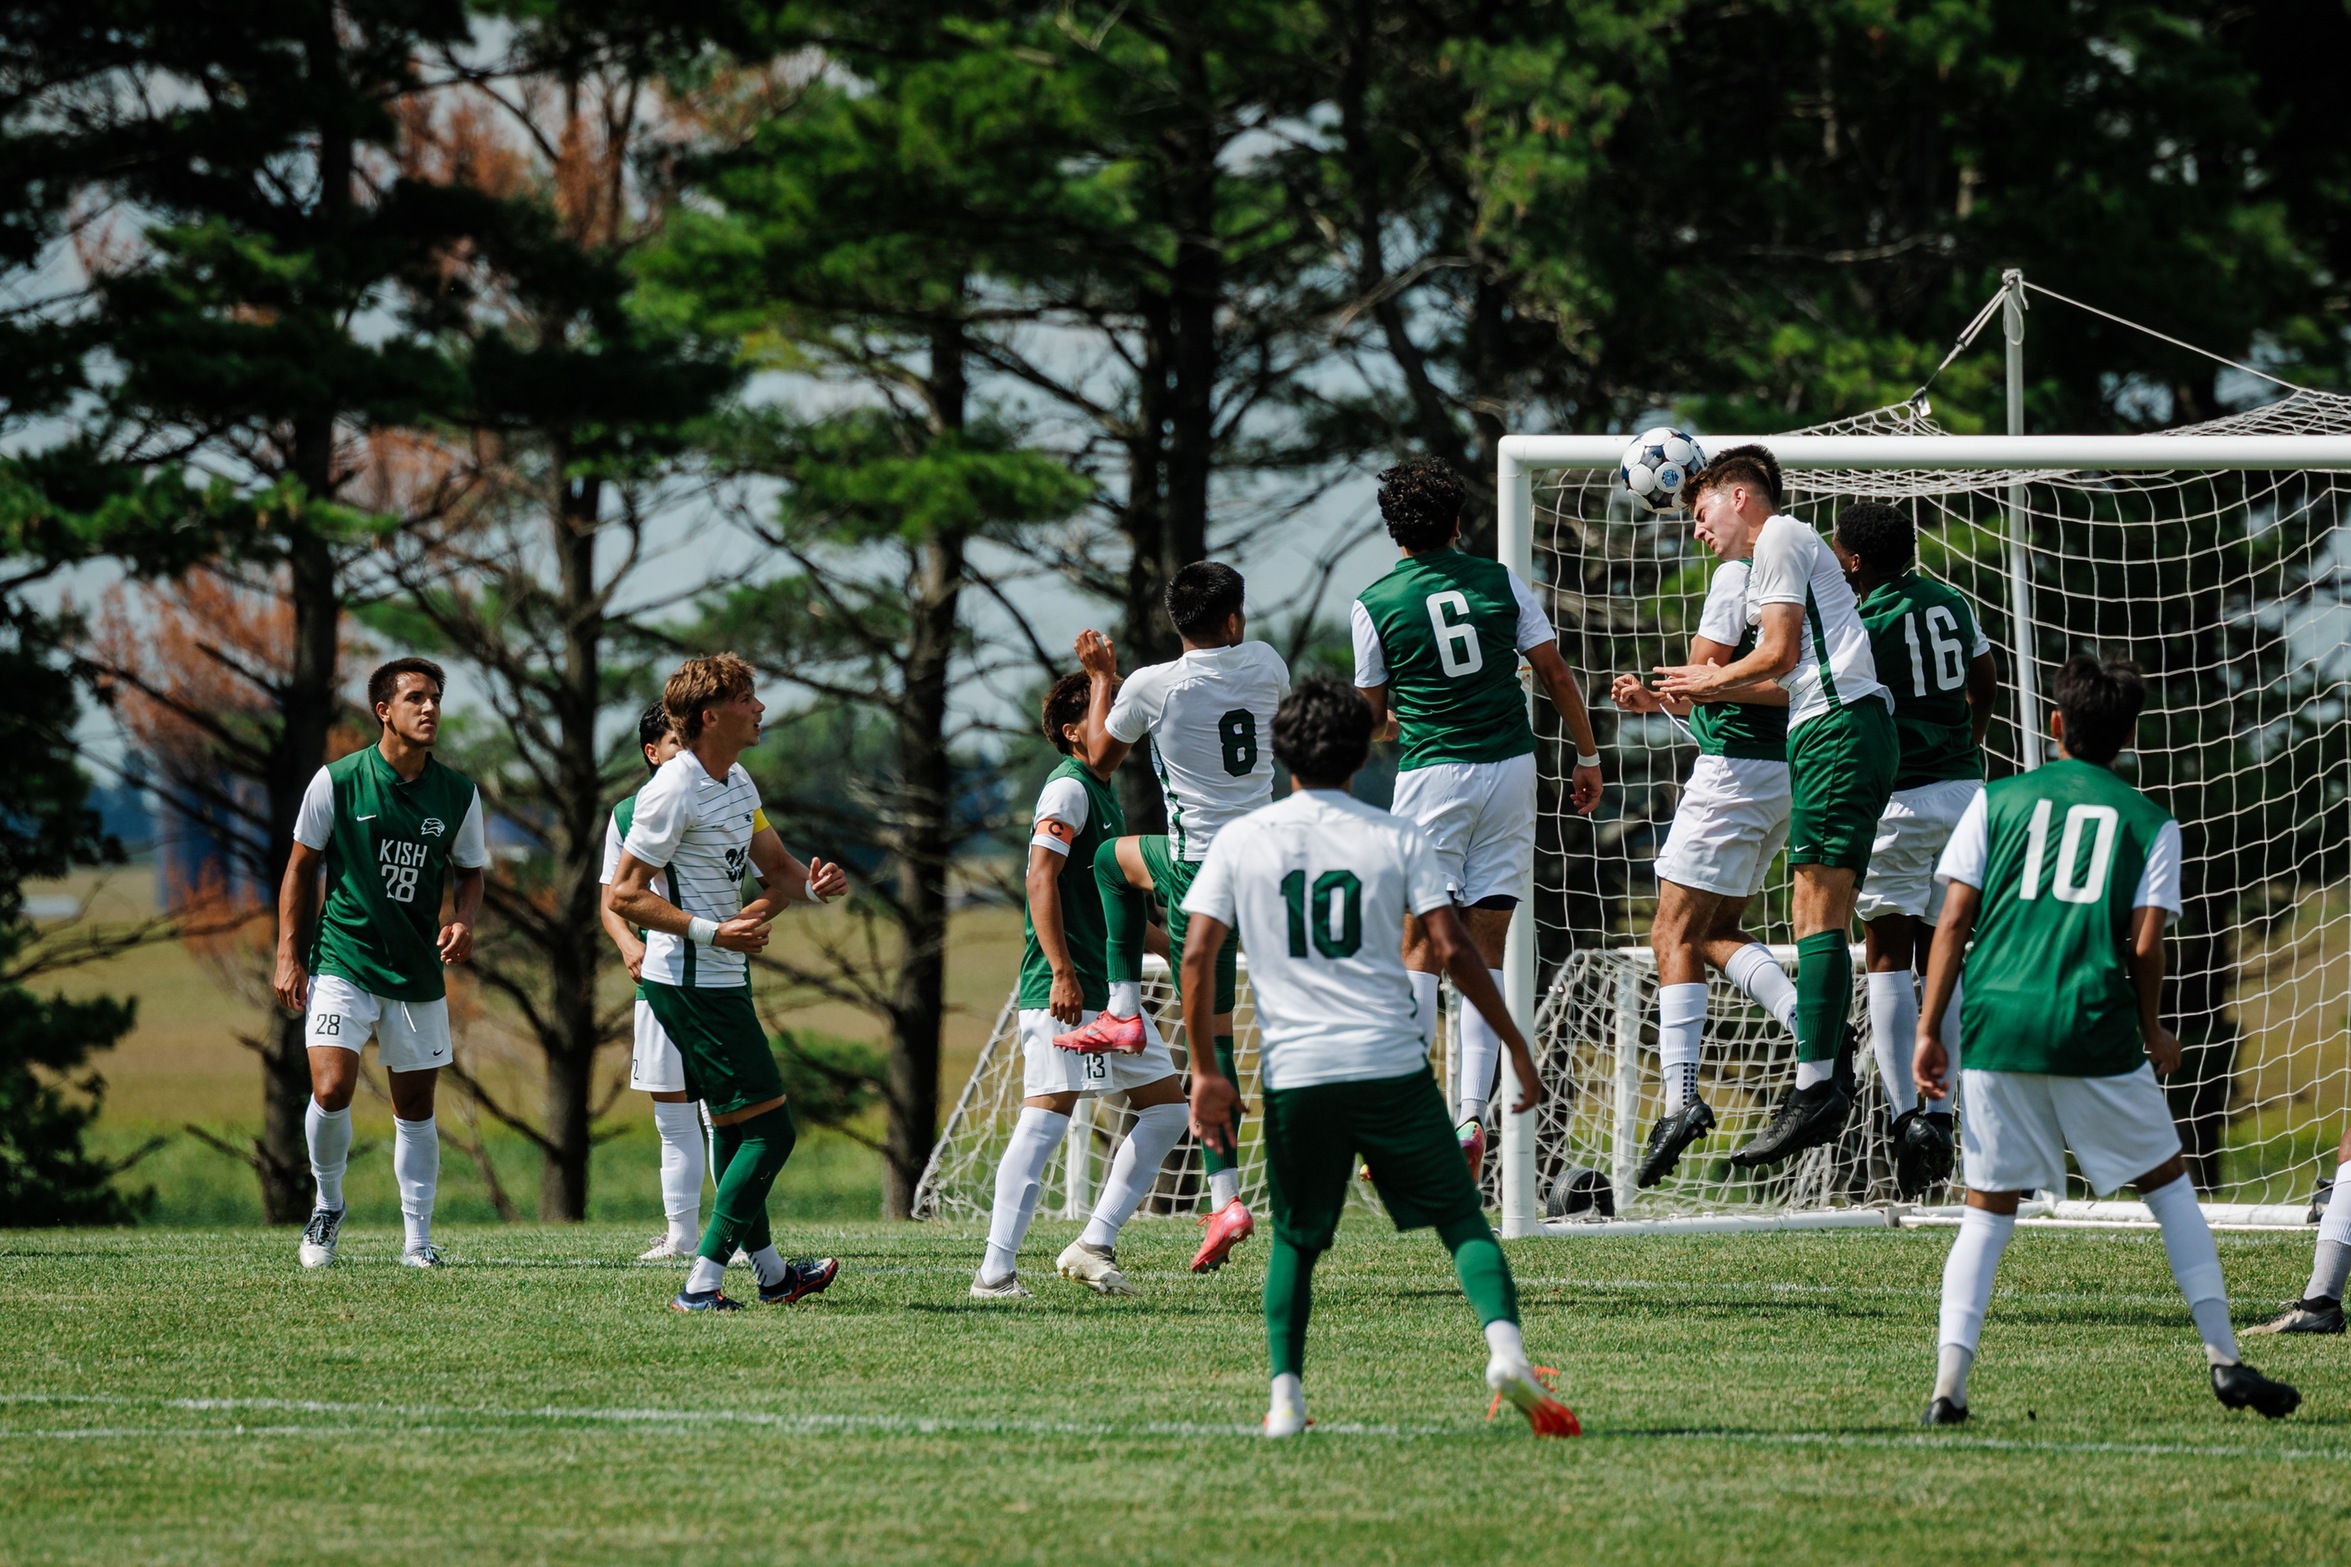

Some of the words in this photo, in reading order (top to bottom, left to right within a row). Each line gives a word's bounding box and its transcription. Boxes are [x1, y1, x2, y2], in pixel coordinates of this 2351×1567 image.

[1426, 590, 1483, 678] 6
[1905, 605, 1965, 697] 16
[1218, 708, 1258, 777] 8
[379, 839, 428, 868] KISH
[1048, 821, 1064, 836] C
[2019, 798, 2119, 904] 10
[381, 864, 419, 903] 28
[1279, 870, 1362, 959] 10
[315, 1014, 341, 1036] 28
[1086, 1055, 1106, 1079] 13
